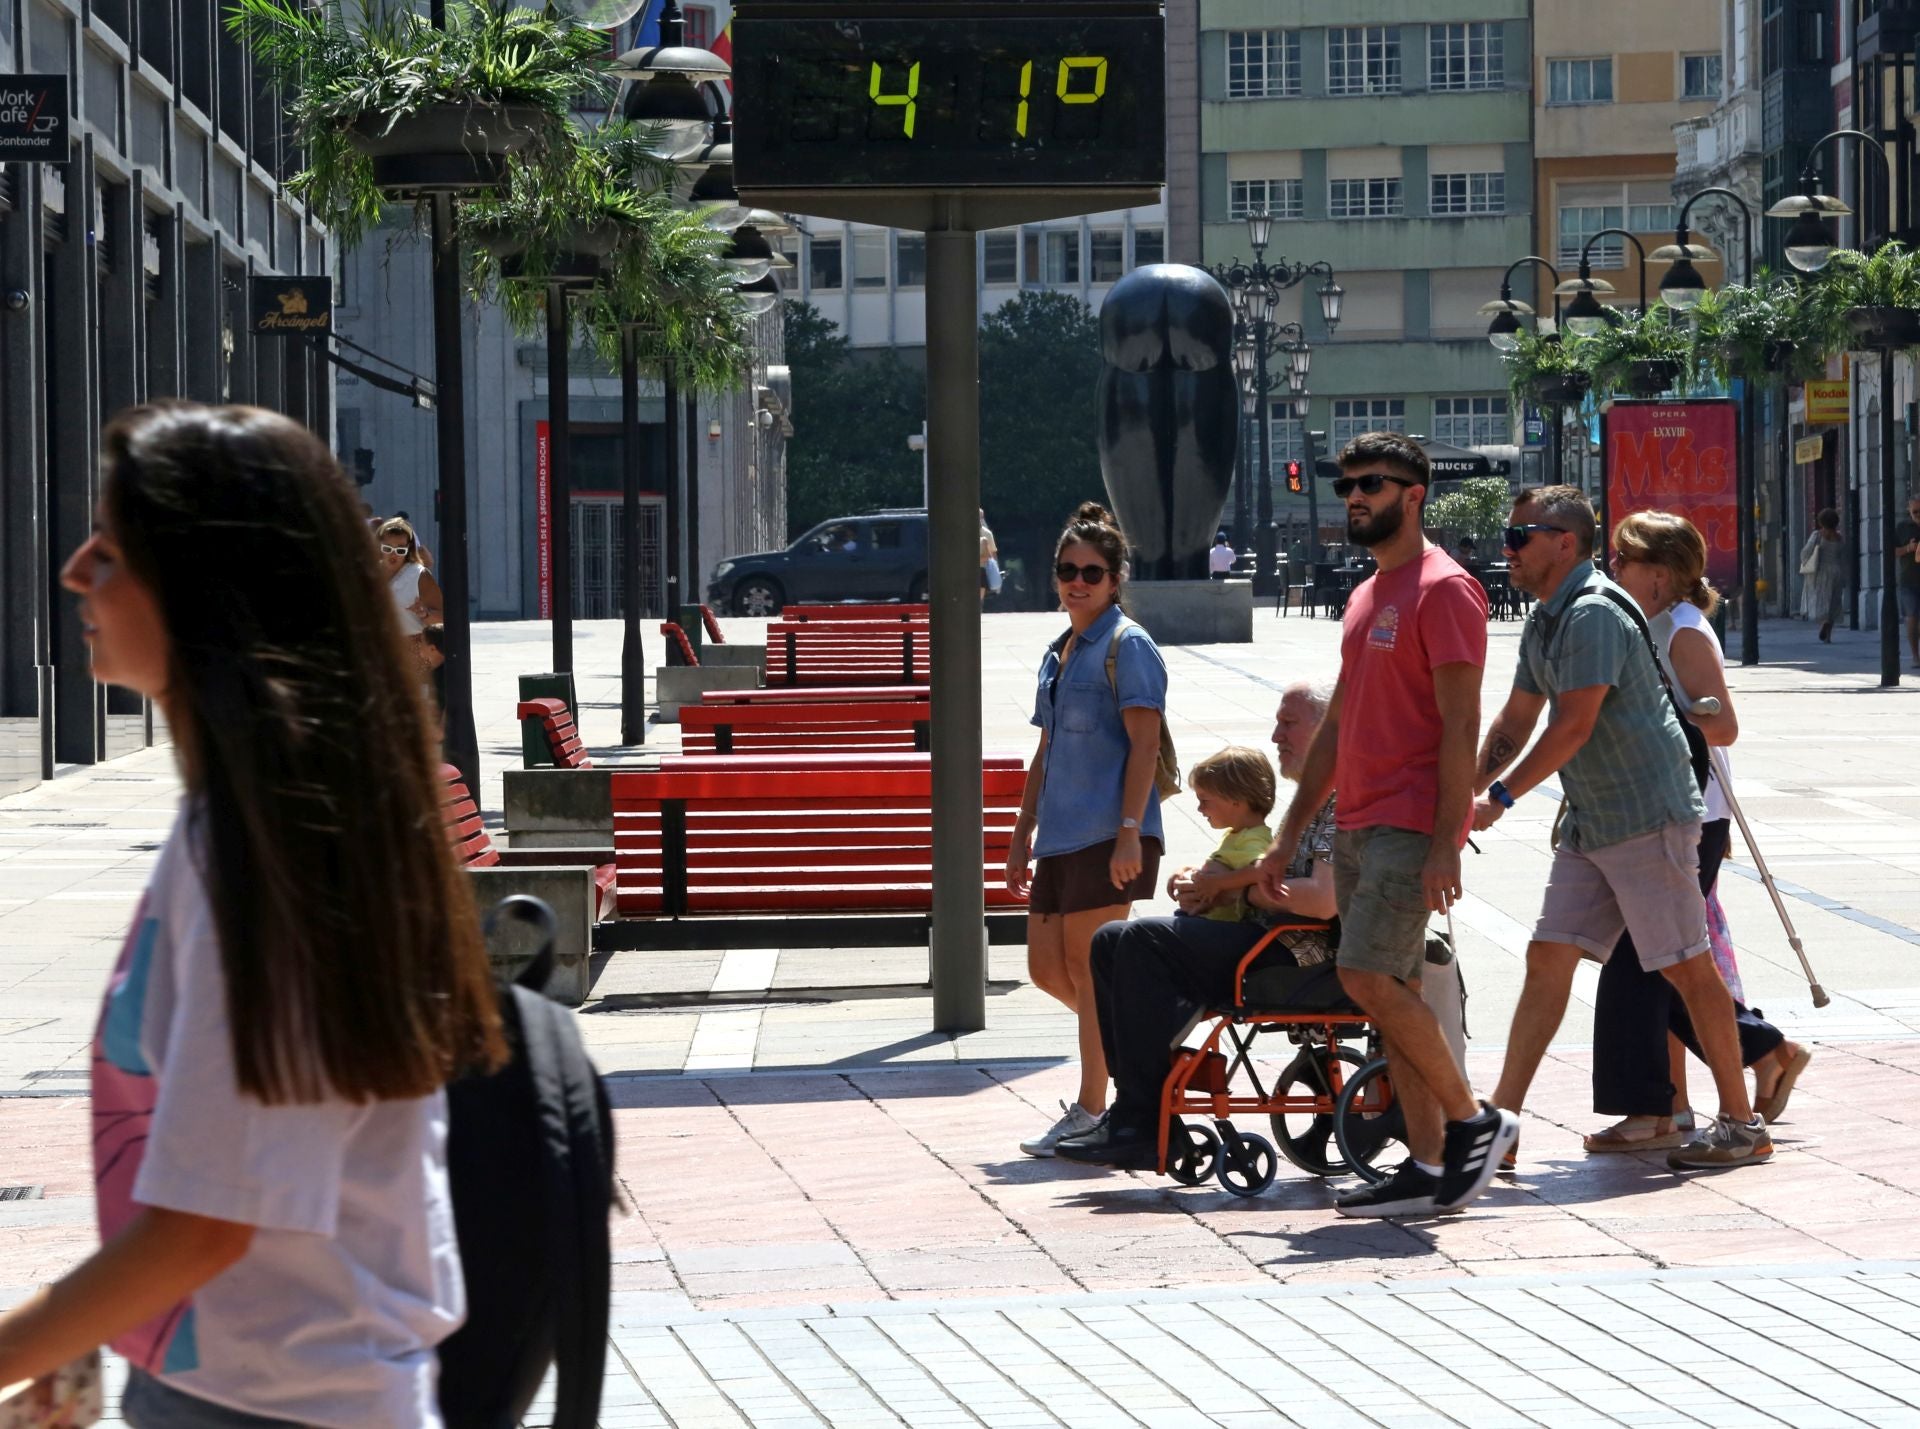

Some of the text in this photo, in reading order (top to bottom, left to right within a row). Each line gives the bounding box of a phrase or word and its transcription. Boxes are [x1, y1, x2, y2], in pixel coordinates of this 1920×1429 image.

[0, 106, 29, 123] afé
[1813, 388, 1848, 399] Kodak
[1652, 410, 1687, 418] OPERA
[1653, 426, 1686, 438] LXXVIII
[539, 436, 547, 467] SOCIAL
[1430, 462, 1475, 471] RBUCKS
[1610, 429, 1729, 497] Más
[539, 468, 548, 515] SEGURIDAD
[540, 516, 548, 528] LA
[541, 528, 548, 540] DE
